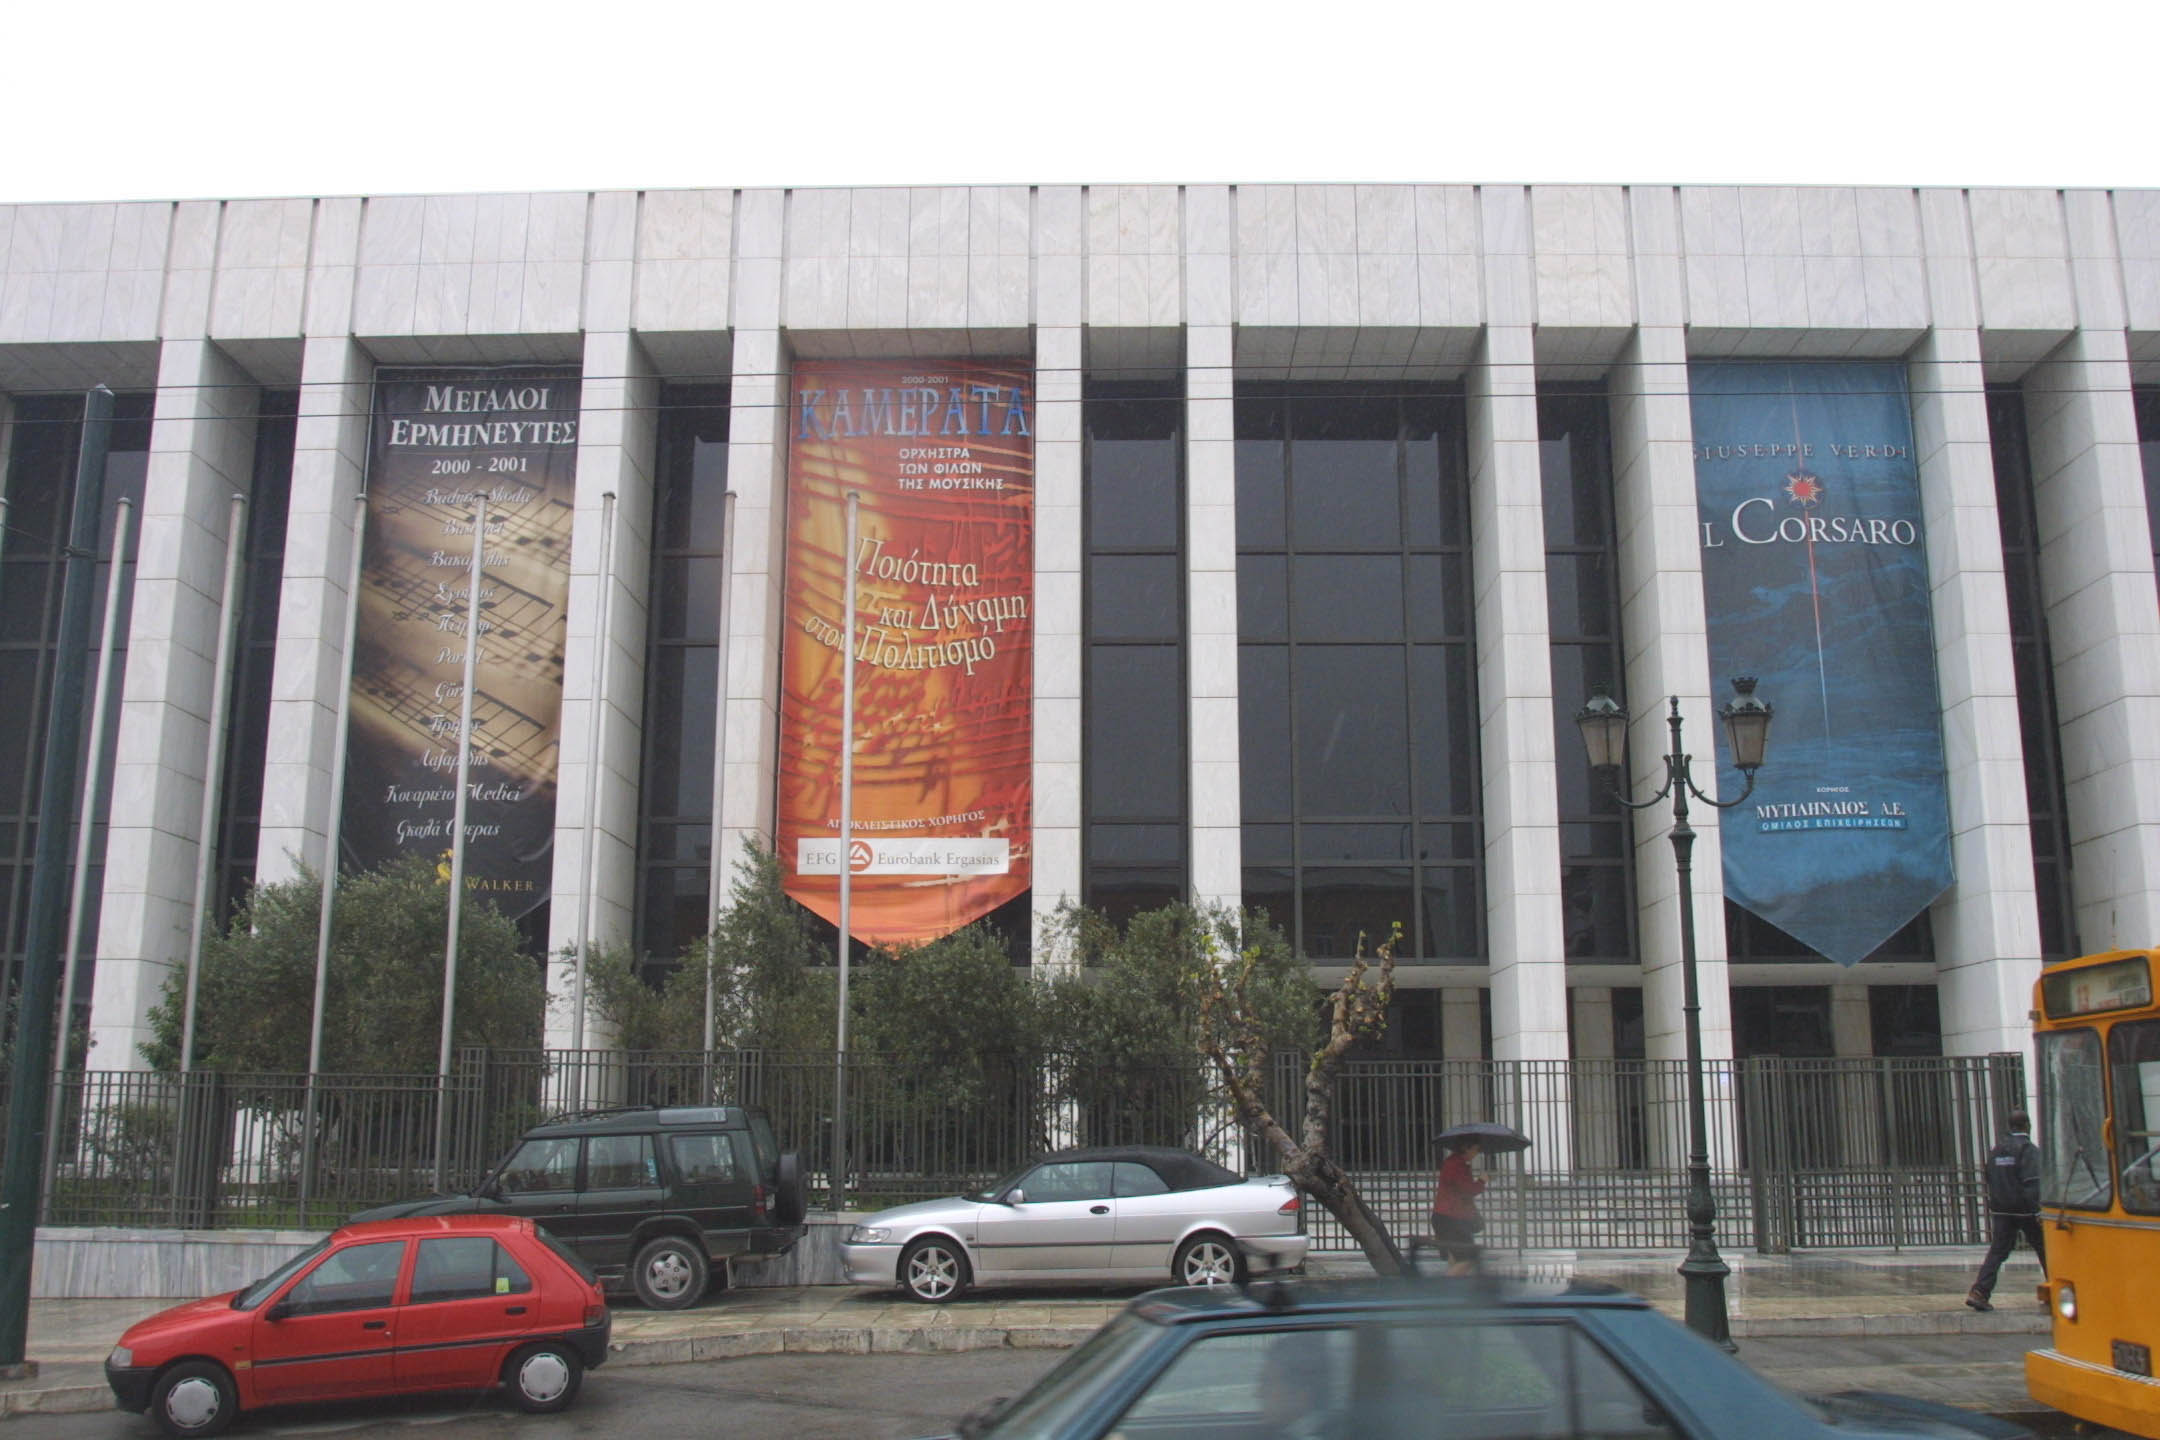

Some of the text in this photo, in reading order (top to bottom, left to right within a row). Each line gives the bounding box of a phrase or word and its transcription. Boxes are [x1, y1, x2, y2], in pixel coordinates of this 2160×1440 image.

[424, 386, 549, 412] ΜΕΓΑΛΟΙ
[797, 384, 1031, 440] ΚΑΜΕΡΑΤΑ
[388, 420, 577, 446] ΕΡΜΗΝΕΥΤΕΣ
[899, 448, 970, 459] ΟΡΧΗΣΤΡΑ
[1693, 443, 1907, 460] IUSEPPE VERDI
[432, 460, 470, 474] 2000
[488, 457, 528, 472] 2001
[899, 463, 982, 474] ΤΩΝ ΦΙΛΩΝ
[898, 478, 1004, 490] ΤΗΣ ΜΟΥΣΙΚΗΣ
[855, 537, 979, 587] Ποιότητα
[879, 592, 1027, 633] και Δύναμη
[856, 625, 996, 676] Πολιτισμό
[1757, 801, 1869, 819] ΜΥΤΙΛΗΝΑΙΟΣ
[928, 810, 985, 828] ΧΟΡΗΓΟΣ
[1762, 820, 1809, 831] ΟΜΙΛΟΣ
[806, 851, 1000, 867] EFG Eurobank Ergasias
[465, 876, 534, 890] WALKER
